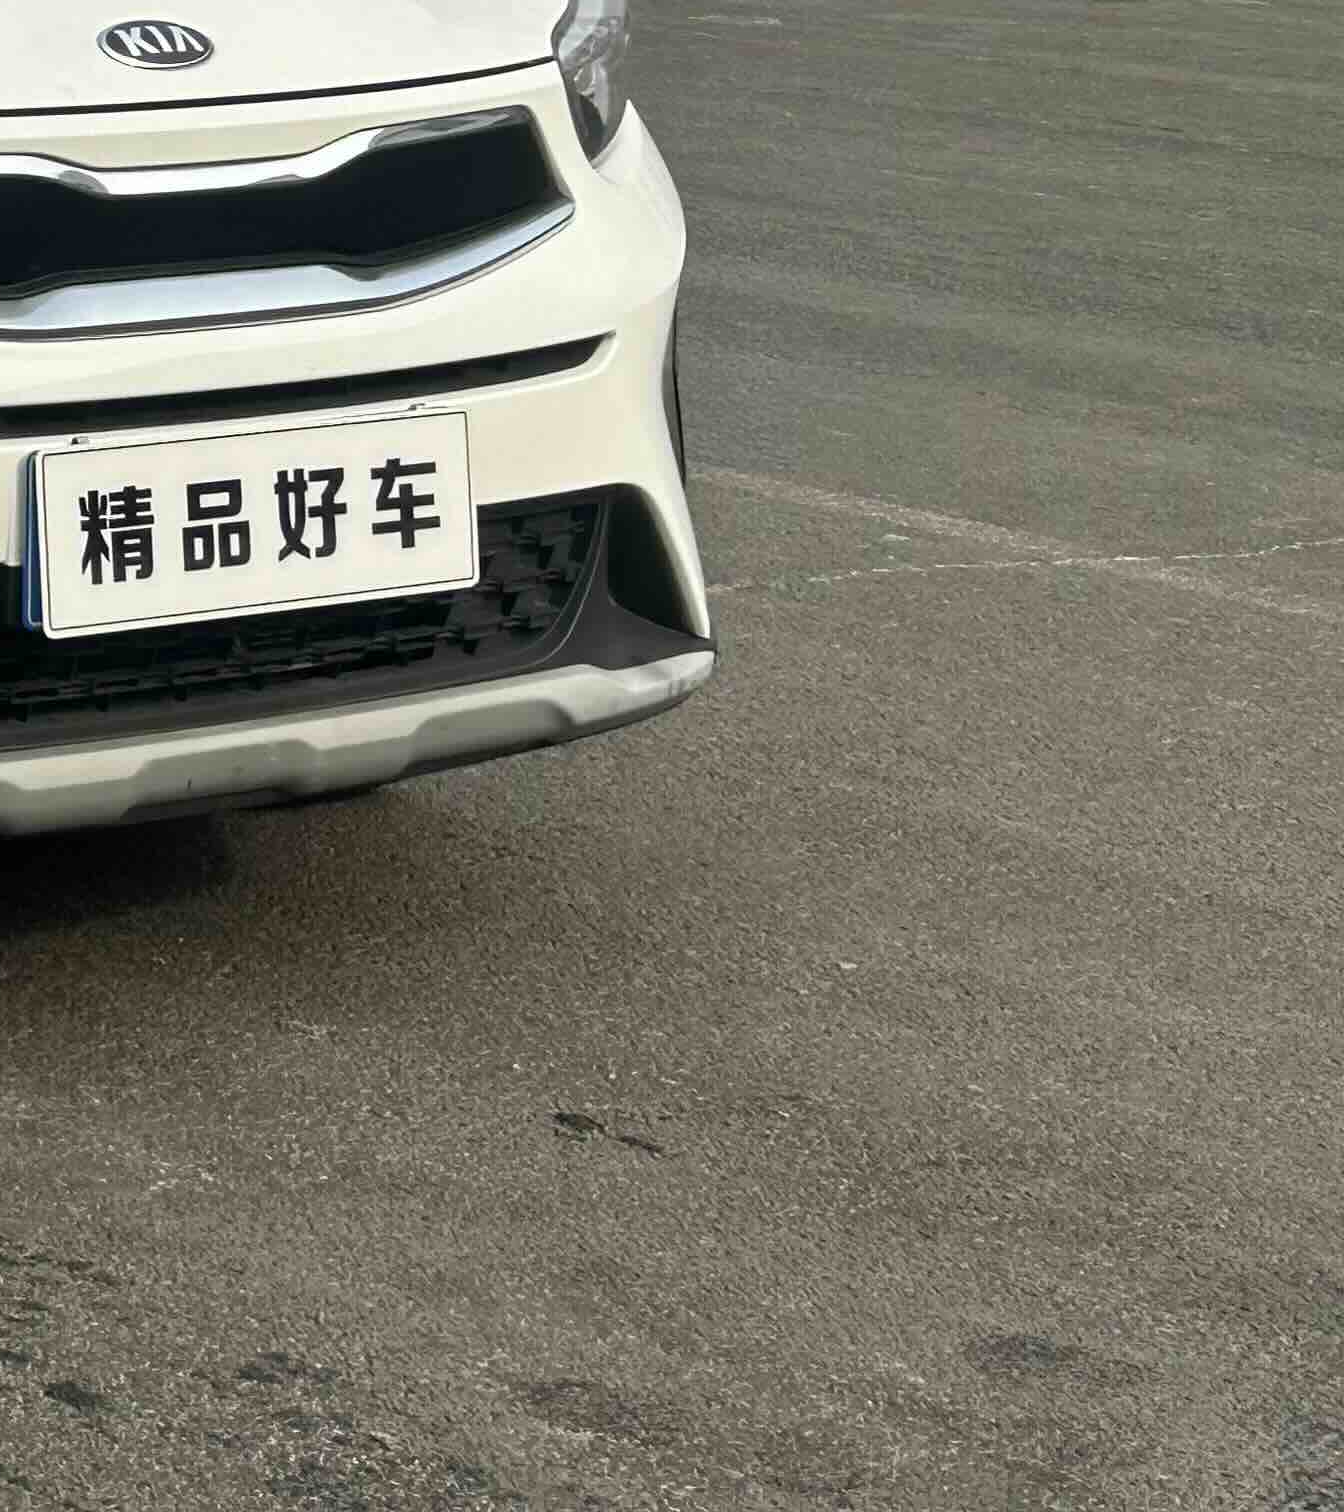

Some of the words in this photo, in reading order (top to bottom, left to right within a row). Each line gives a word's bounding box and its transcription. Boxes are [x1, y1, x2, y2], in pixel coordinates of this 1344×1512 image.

[113, 24, 205, 57] KIA
[77, 457, 442, 585] 精品好车
